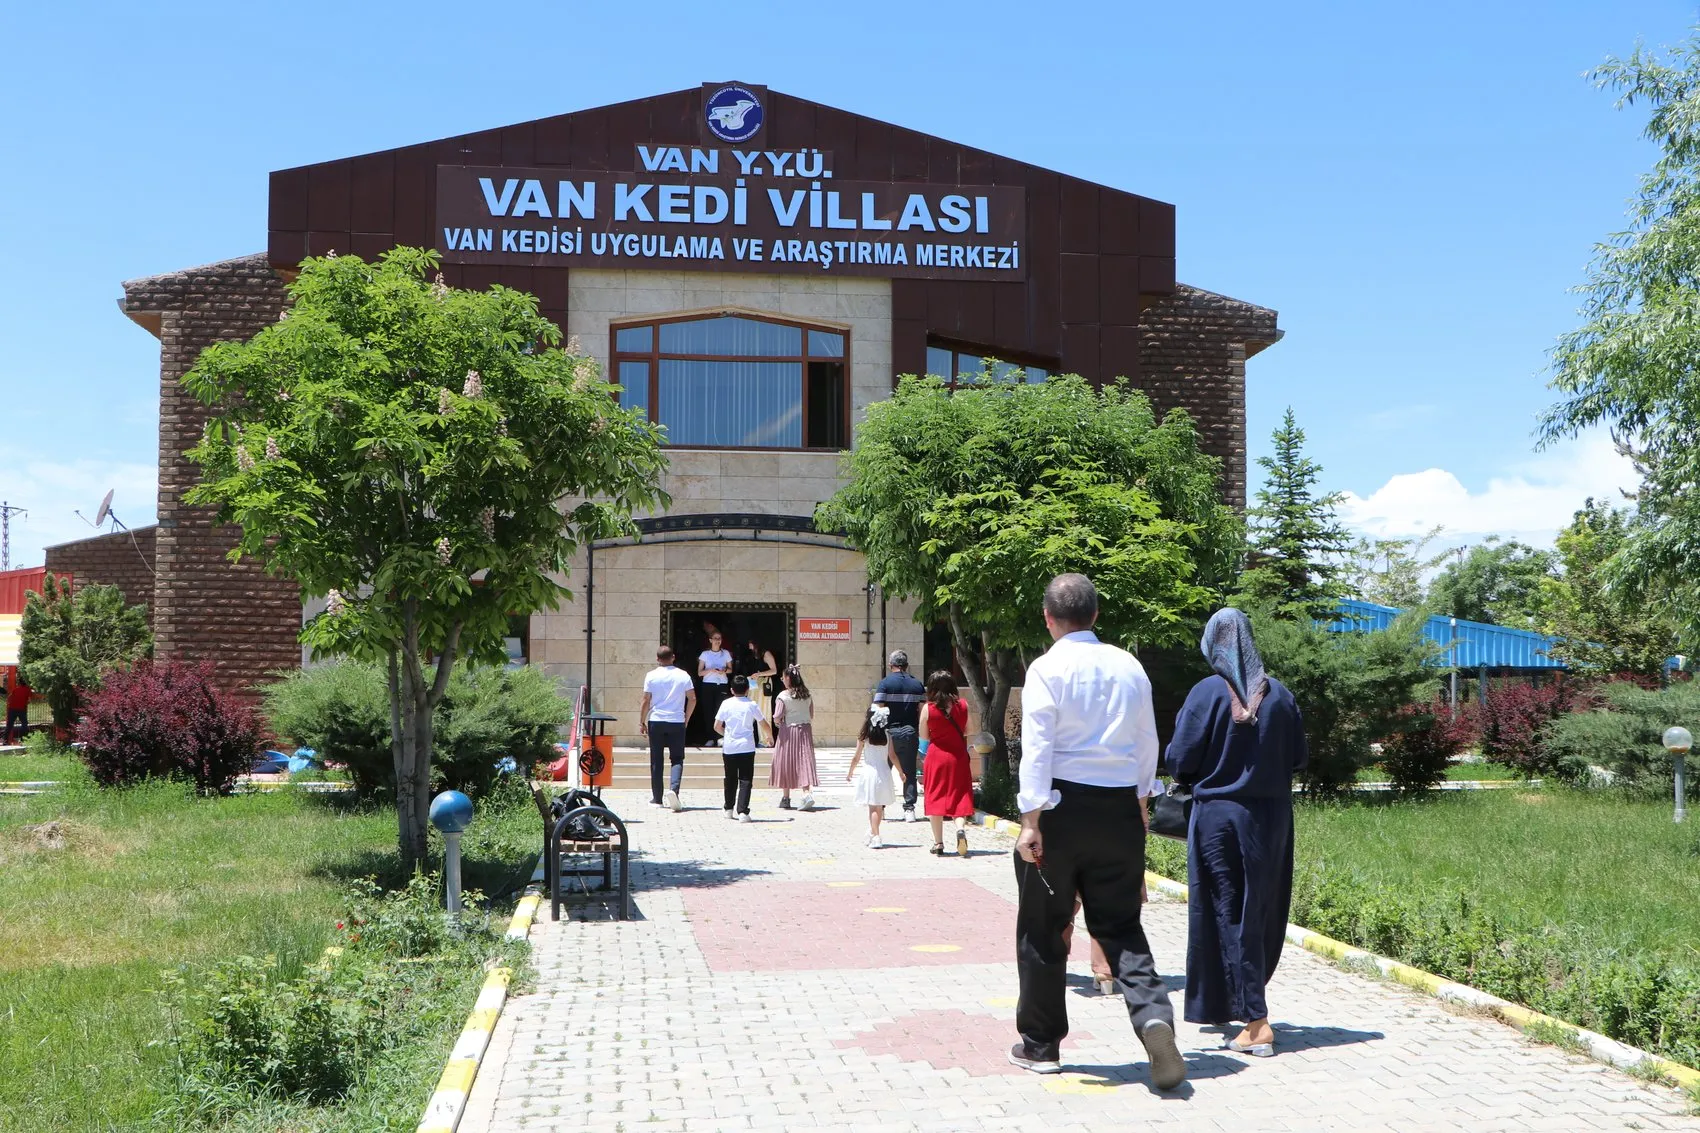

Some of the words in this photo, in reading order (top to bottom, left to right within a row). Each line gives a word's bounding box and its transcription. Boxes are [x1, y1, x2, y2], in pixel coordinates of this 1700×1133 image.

[637, 145, 719, 174] VAN
[731, 148, 833, 179] Y.Y.Ü.
[478, 177, 596, 220] VAN
[614, 178, 747, 225] KEDİ
[767, 181, 989, 233] VİLLASI
[443, 227, 493, 251] VAN
[501, 225, 583, 255] KEDİSİ
[591, 232, 725, 260] UYGULAMA
[732, 237, 763, 261] VE
[770, 239, 909, 269] ARAŞTIRMA
[916, 240, 1019, 269] MERKEZİ
[810, 622, 821, 630] VAN
[821, 621, 838, 630] KEDİSİ
